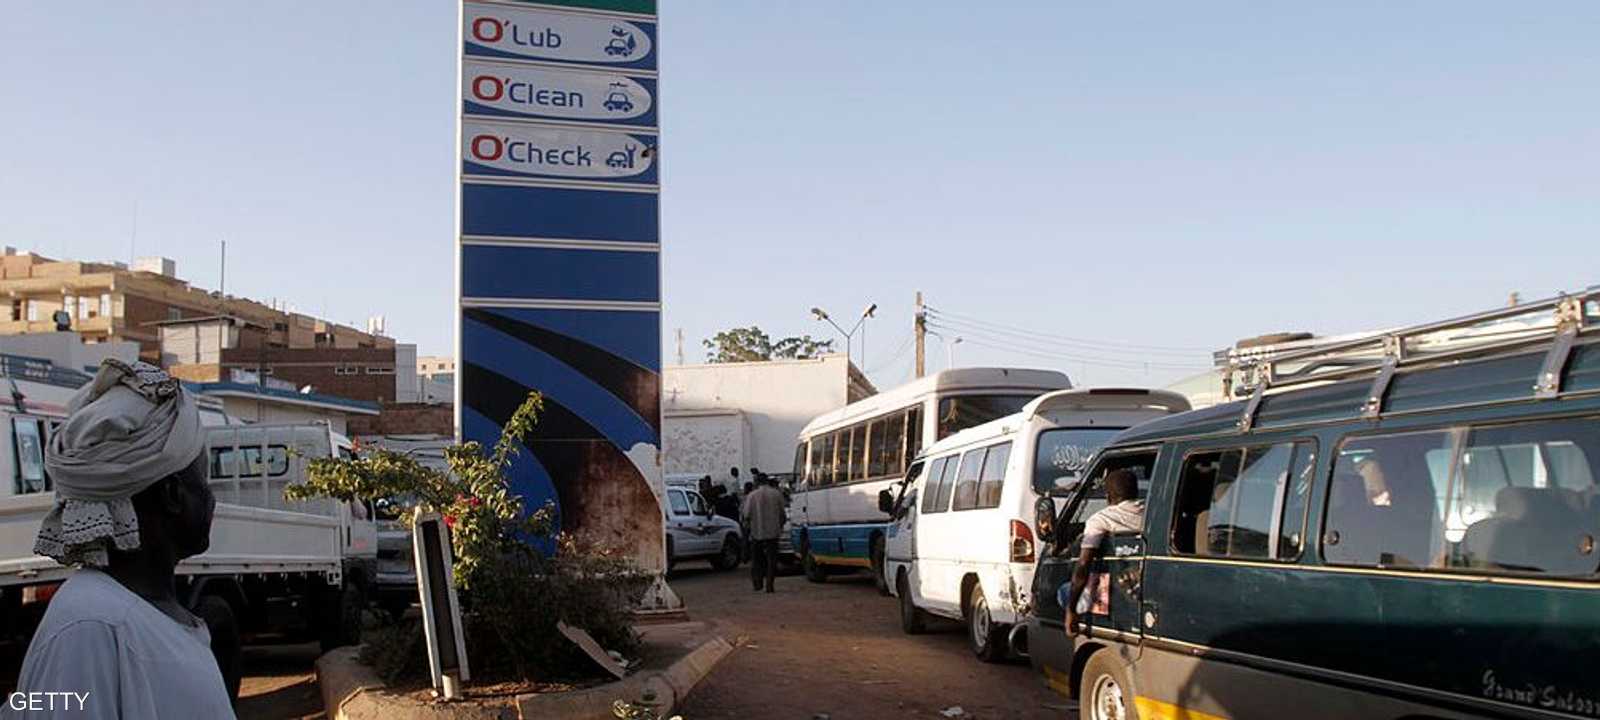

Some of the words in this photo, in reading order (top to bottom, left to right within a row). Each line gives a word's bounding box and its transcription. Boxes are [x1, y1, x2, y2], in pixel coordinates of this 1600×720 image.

[472, 17, 562, 48] O'Lub
[472, 75, 584, 108] O'Clean
[470, 135, 592, 167] O'Check
